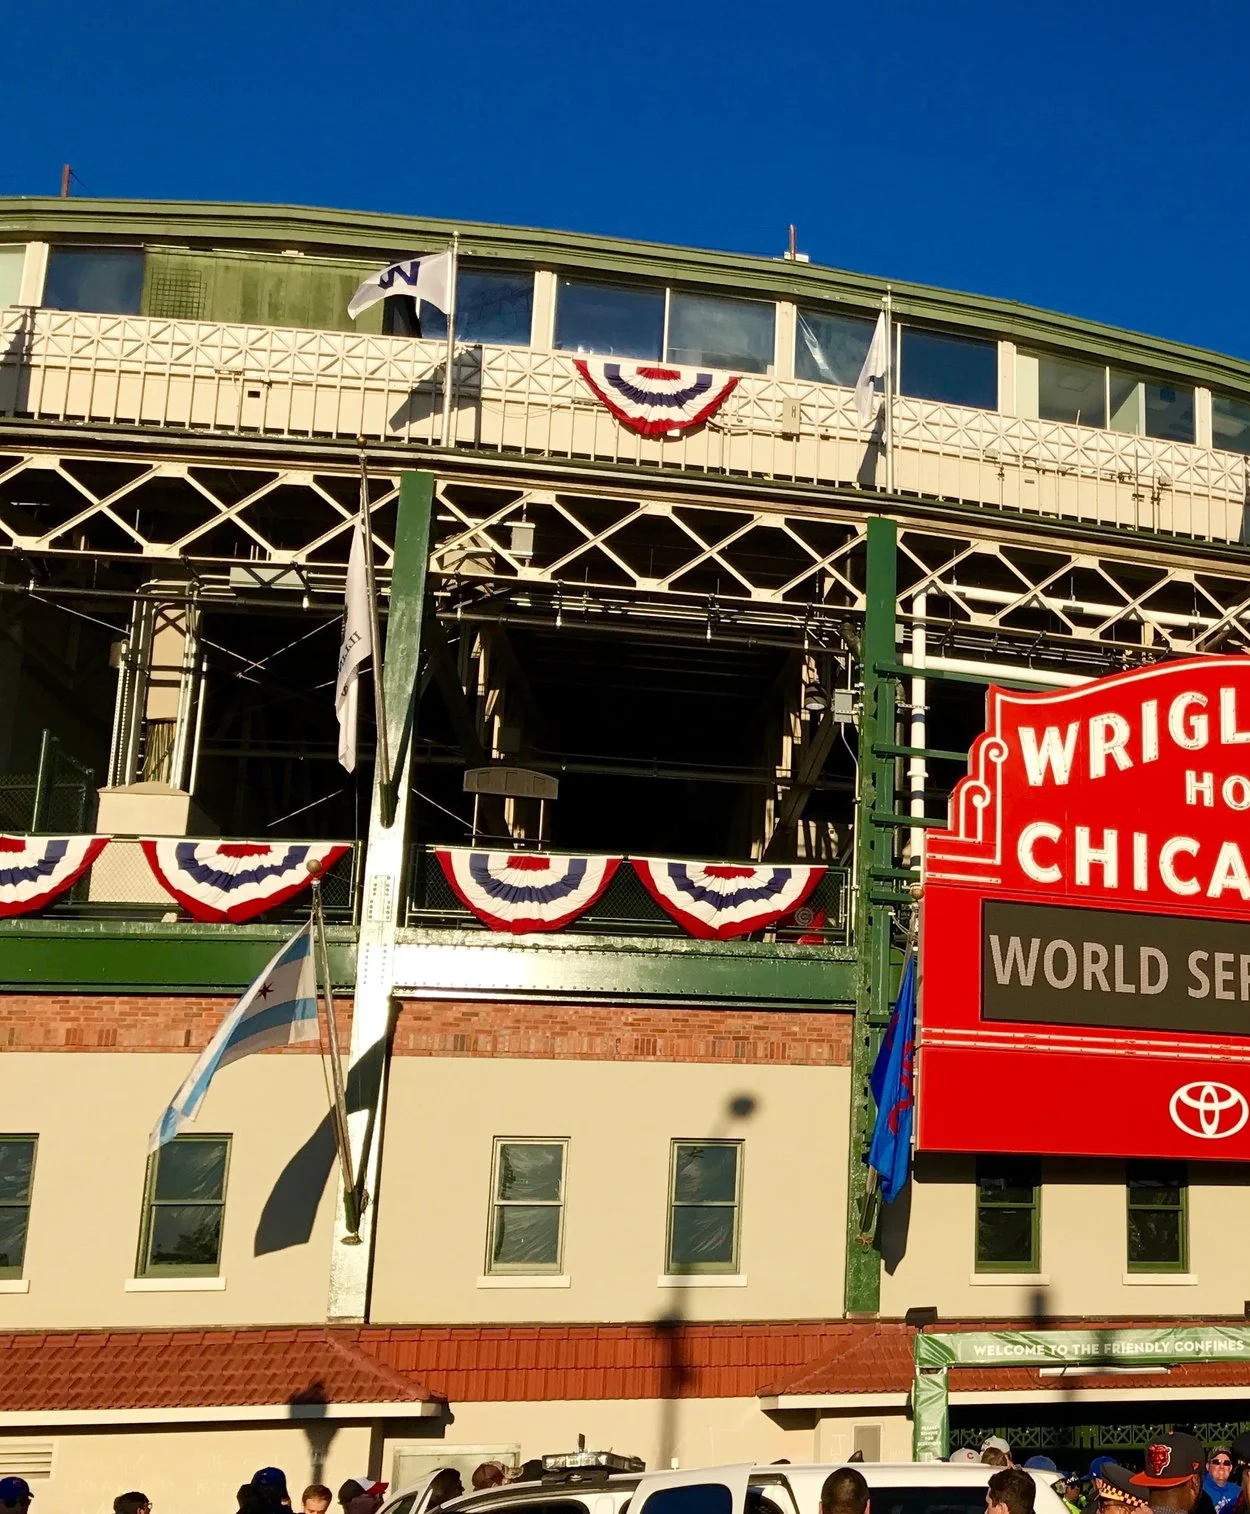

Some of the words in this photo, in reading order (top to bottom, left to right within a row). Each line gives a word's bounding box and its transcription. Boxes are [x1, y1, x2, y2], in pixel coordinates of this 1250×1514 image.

[988, 934, 1169, 995] WORLD
[974, 1344, 1045, 1356] WELCOME
[1050, 1345, 1068, 1356] TO
[1072, 1344, 1099, 1355] THE
[1103, 1342, 1170, 1355] FRIENDLY
[1175, 1340, 1245, 1352] CONFINES
[966, 1452, 974, 1460] C
